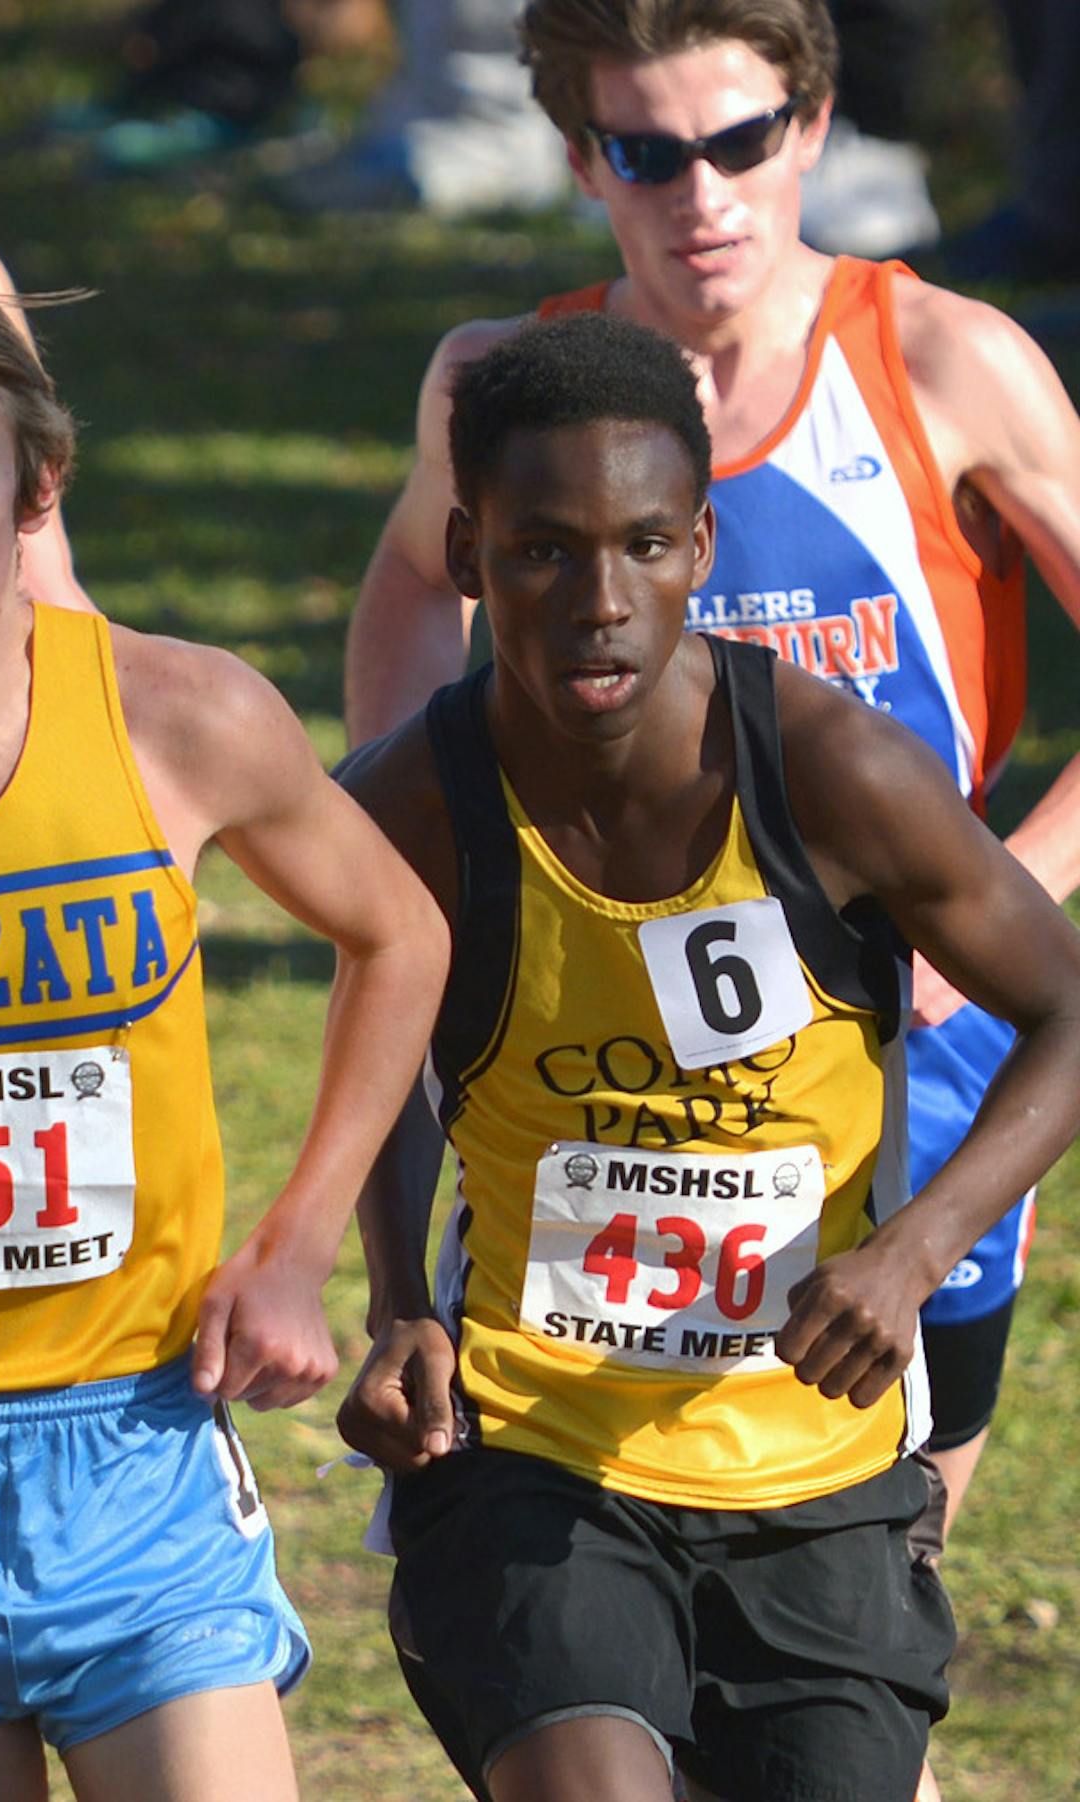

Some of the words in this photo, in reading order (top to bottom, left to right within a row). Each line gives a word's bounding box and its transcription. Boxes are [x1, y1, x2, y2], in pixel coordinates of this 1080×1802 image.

[685, 588, 816, 628] LLERS
[684, 919, 764, 1036] 6
[576, 1074, 782, 1148] PARK
[606, 1160, 764, 1200] MSHSL
[3, 1232, 114, 1272] MEET
[582, 1212, 768, 1321] 436
[543, 1311, 667, 1353] STATE
